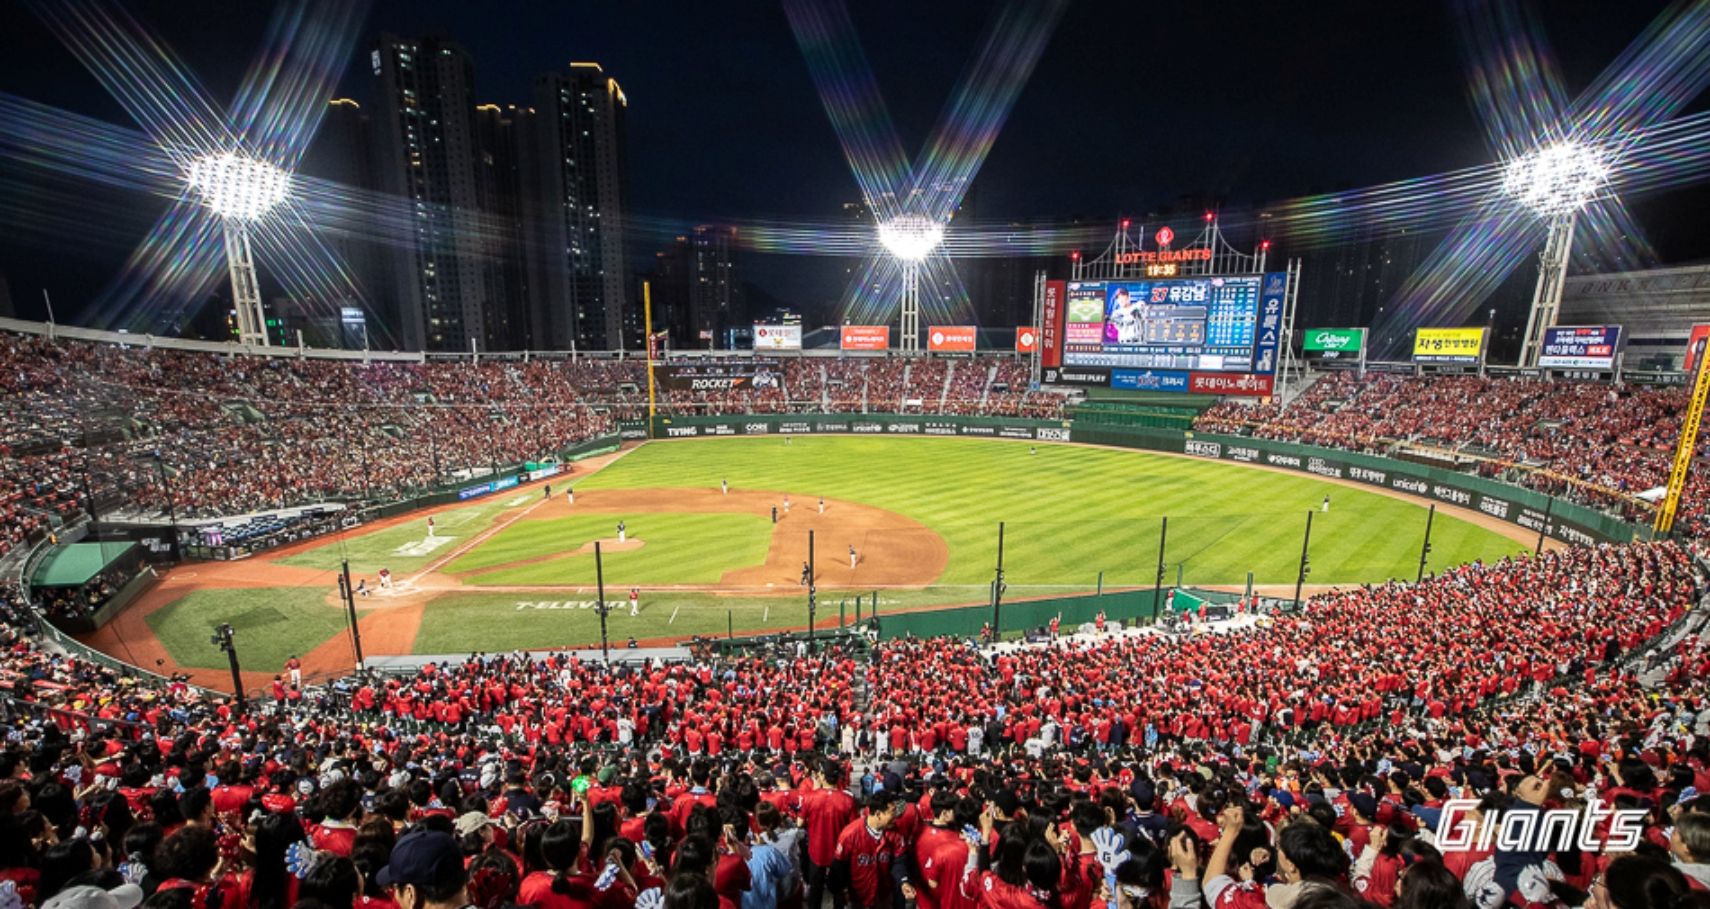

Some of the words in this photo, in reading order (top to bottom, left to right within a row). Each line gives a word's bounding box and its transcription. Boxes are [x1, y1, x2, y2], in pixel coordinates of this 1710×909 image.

[1116, 252, 1156, 264] LOTTE
[1159, 248, 1211, 262] GIANTS
[1152, 287, 1168, 302] 27
[1169, 284, 1206, 302] 유강남
[692, 379, 735, 389] ROCKET
[667, 426, 697, 436] TVING
[1392, 478, 1418, 491] unicef
